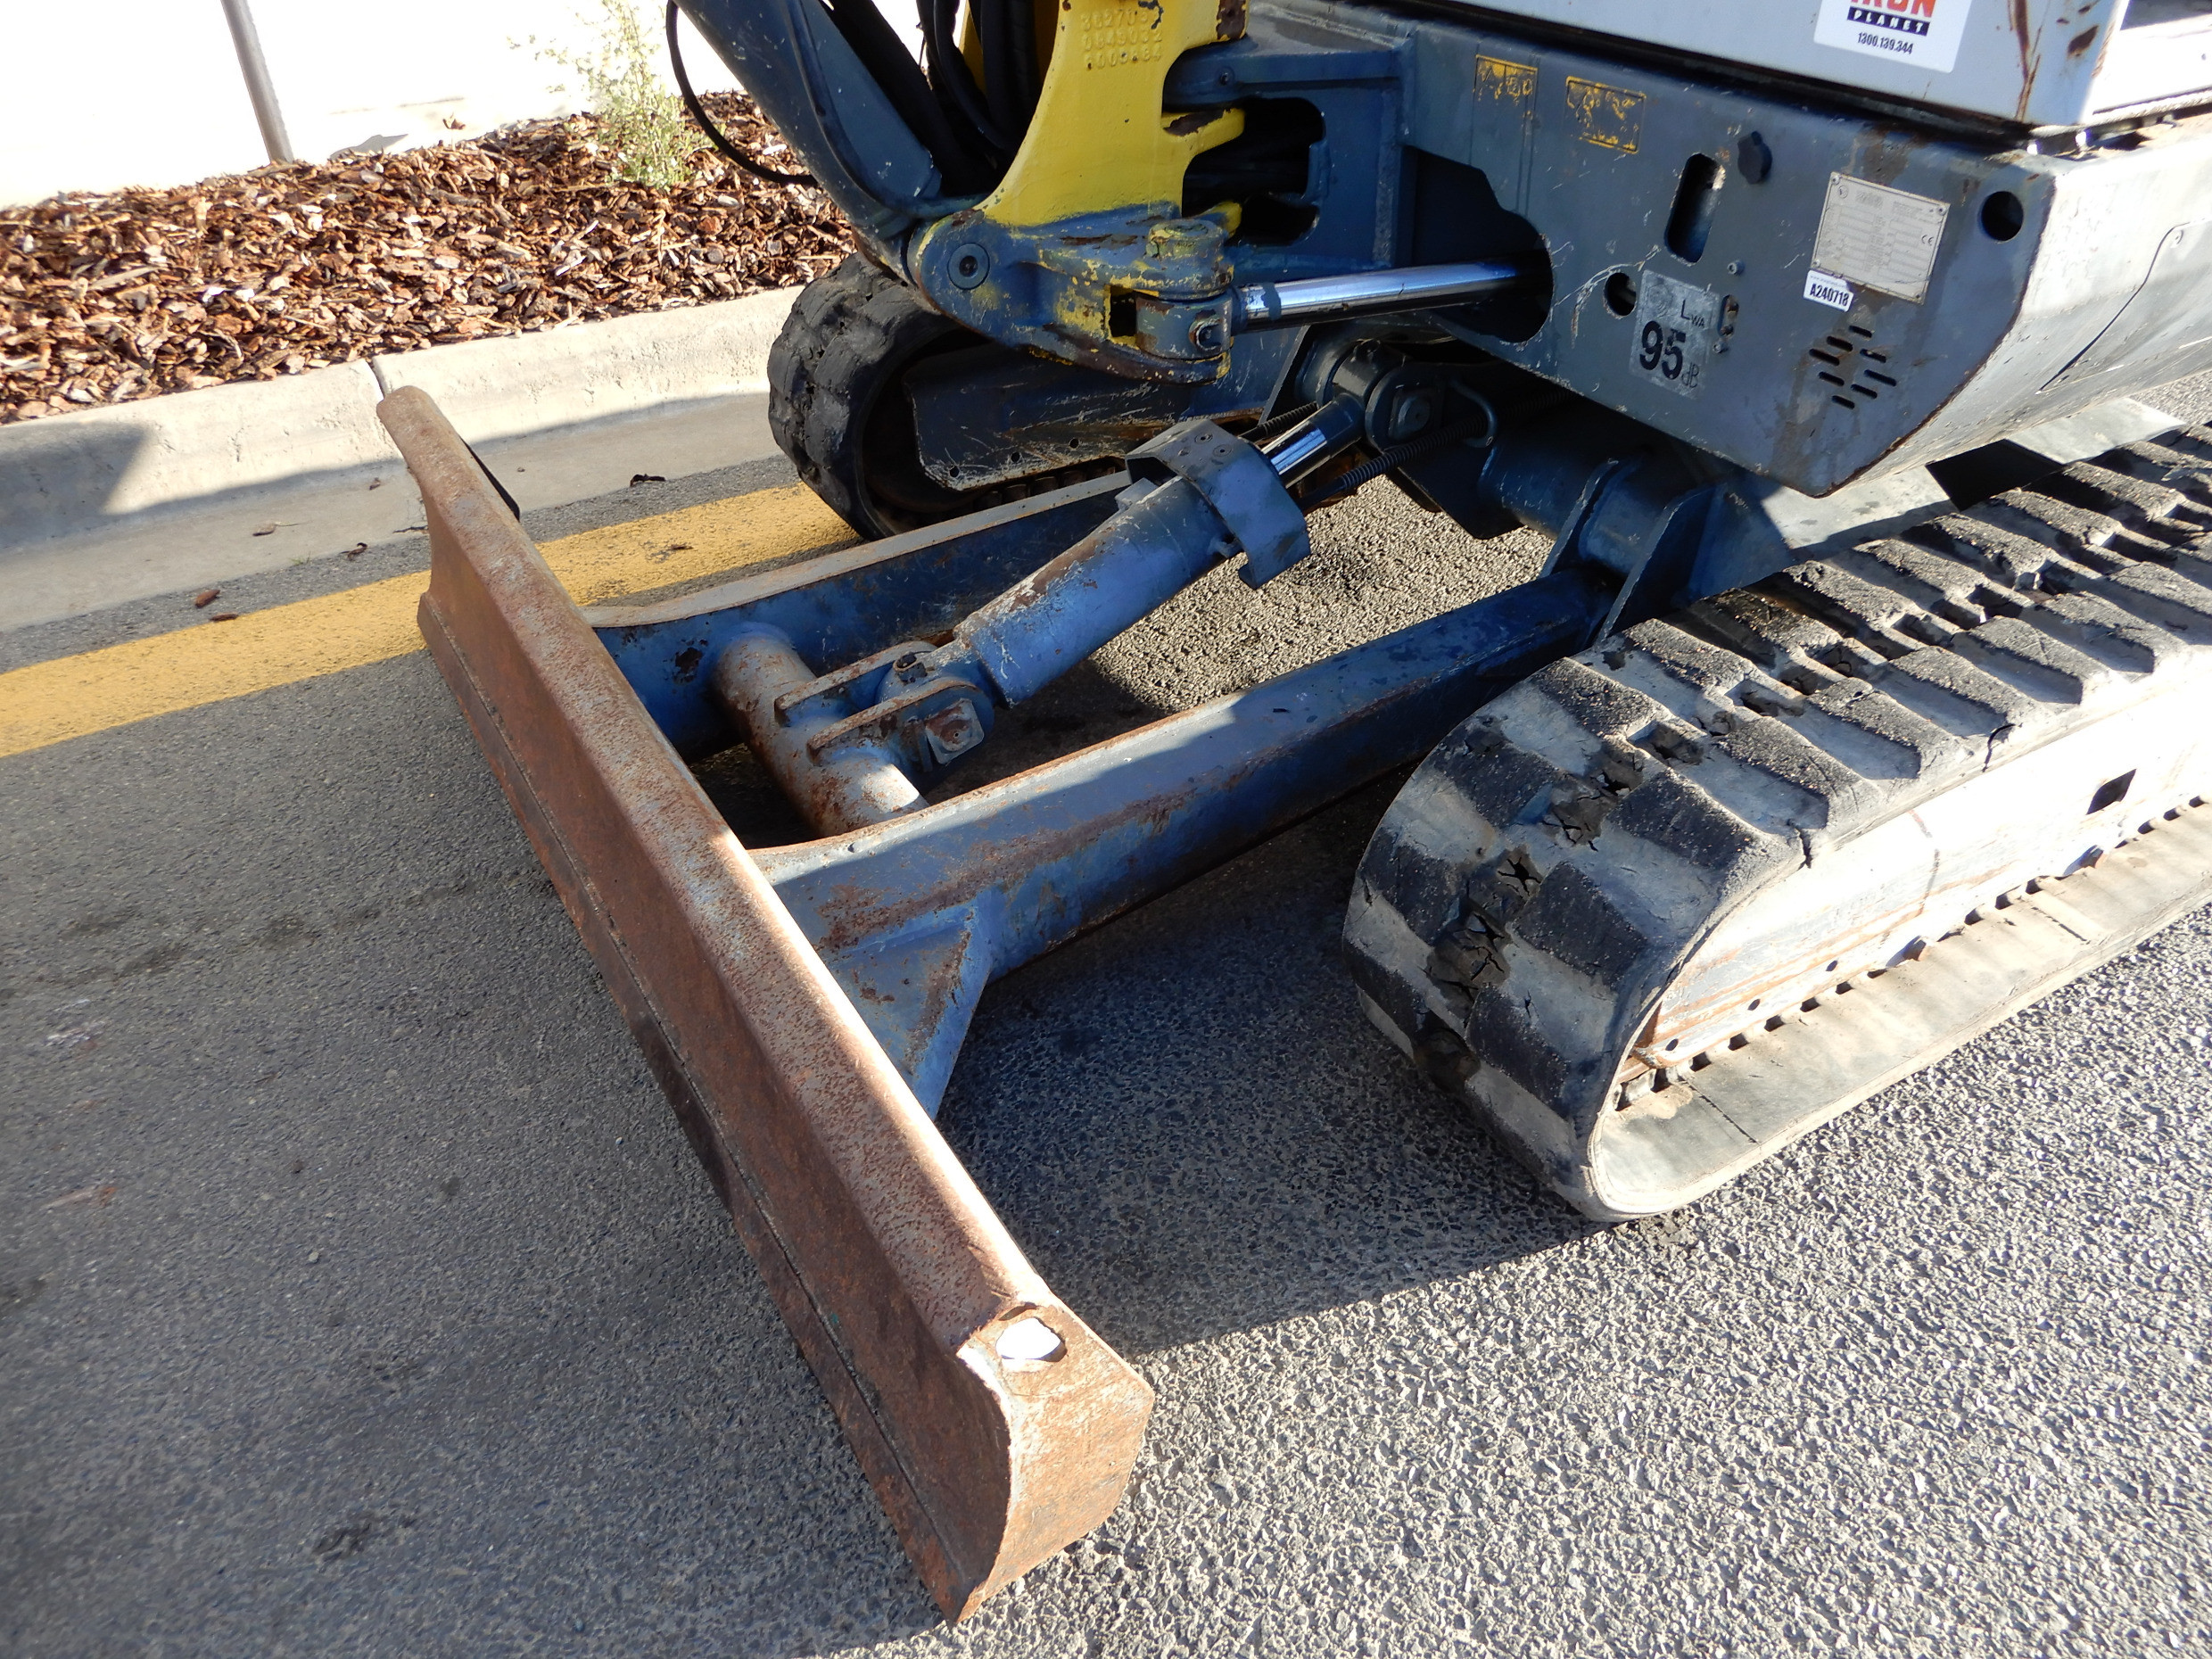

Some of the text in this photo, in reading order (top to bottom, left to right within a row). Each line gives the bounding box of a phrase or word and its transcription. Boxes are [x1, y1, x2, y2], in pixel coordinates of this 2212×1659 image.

[1853, 10, 1924, 33] PLANET
[1858, 32, 1914, 54] 1300.139.344
[1809, 283, 1849, 307] A240718
[1639, 320, 1700, 388] 95 dB
